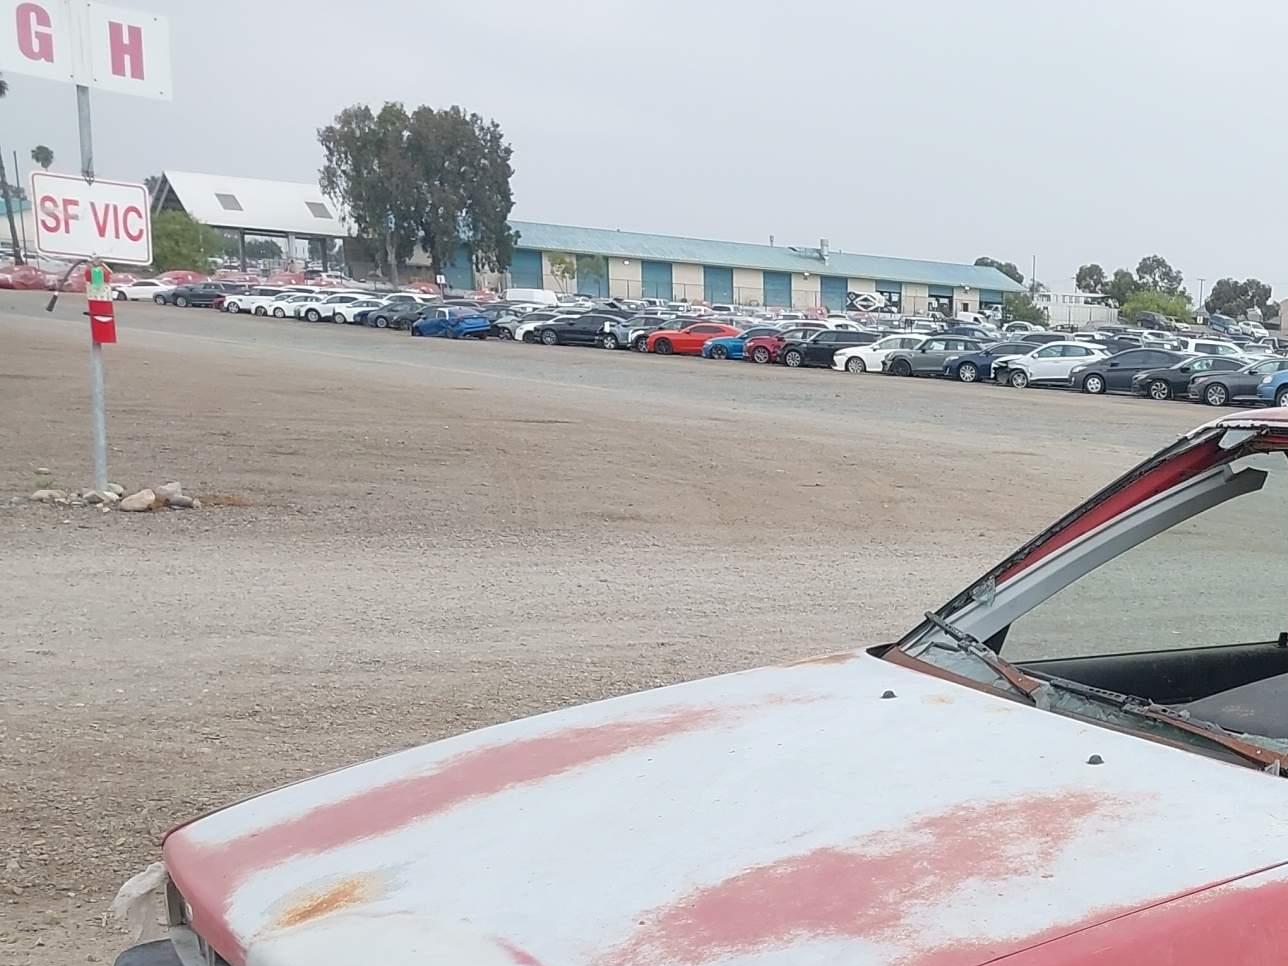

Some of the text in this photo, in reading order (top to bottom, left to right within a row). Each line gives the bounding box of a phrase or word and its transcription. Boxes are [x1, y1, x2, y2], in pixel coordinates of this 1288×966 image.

[16, 2, 54, 63] G
[108, 21, 145, 80] H
[40, 195, 144, 242] SF VIC
